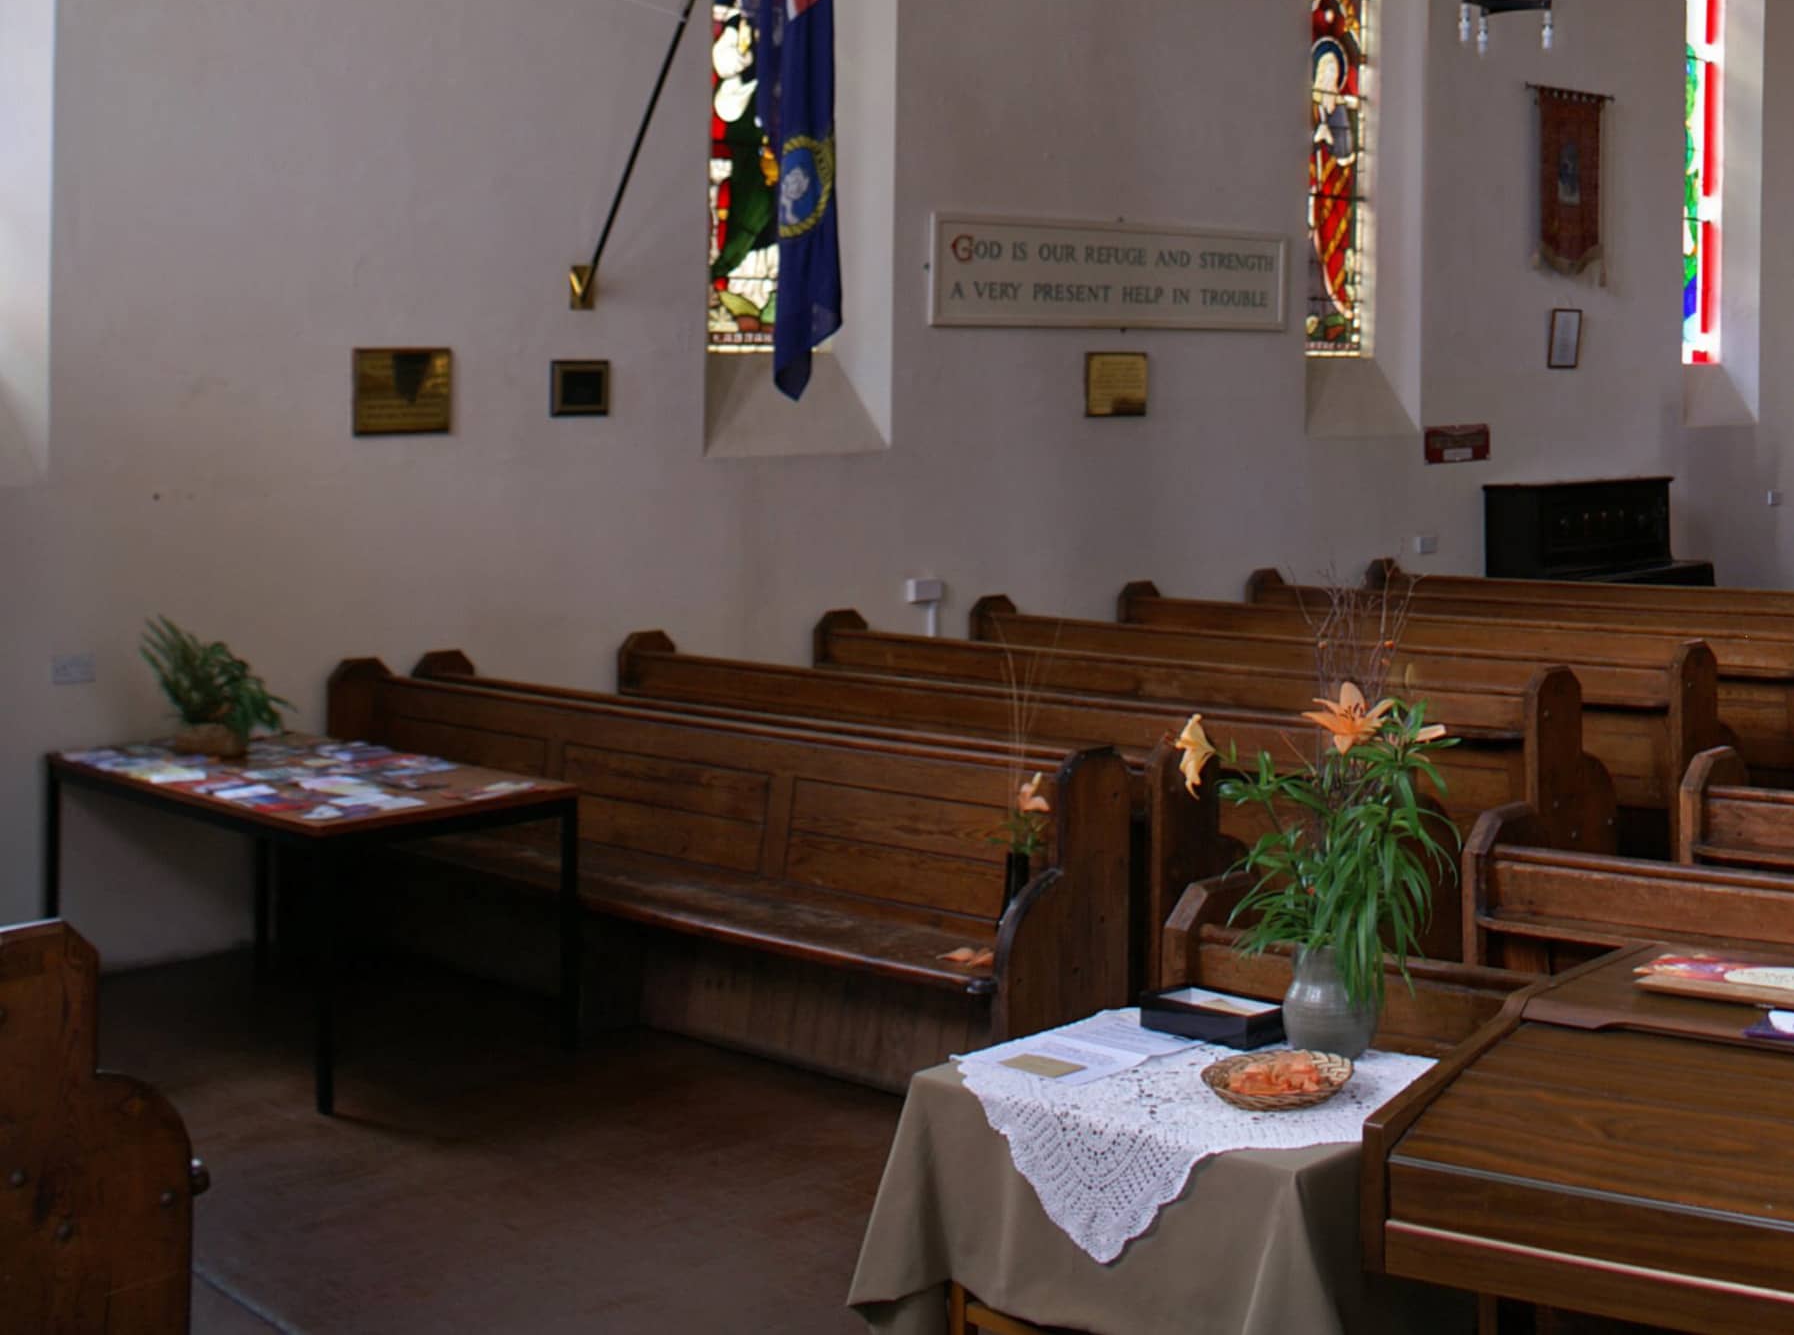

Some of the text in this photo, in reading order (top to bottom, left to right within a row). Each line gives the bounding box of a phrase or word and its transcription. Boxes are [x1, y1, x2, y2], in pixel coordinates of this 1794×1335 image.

[951, 233, 1275, 273] GOD IS OUR REFUGE AND STRENGTH
[950, 280, 1268, 309] A VERY PRESENT HELP IN TROUBLE
